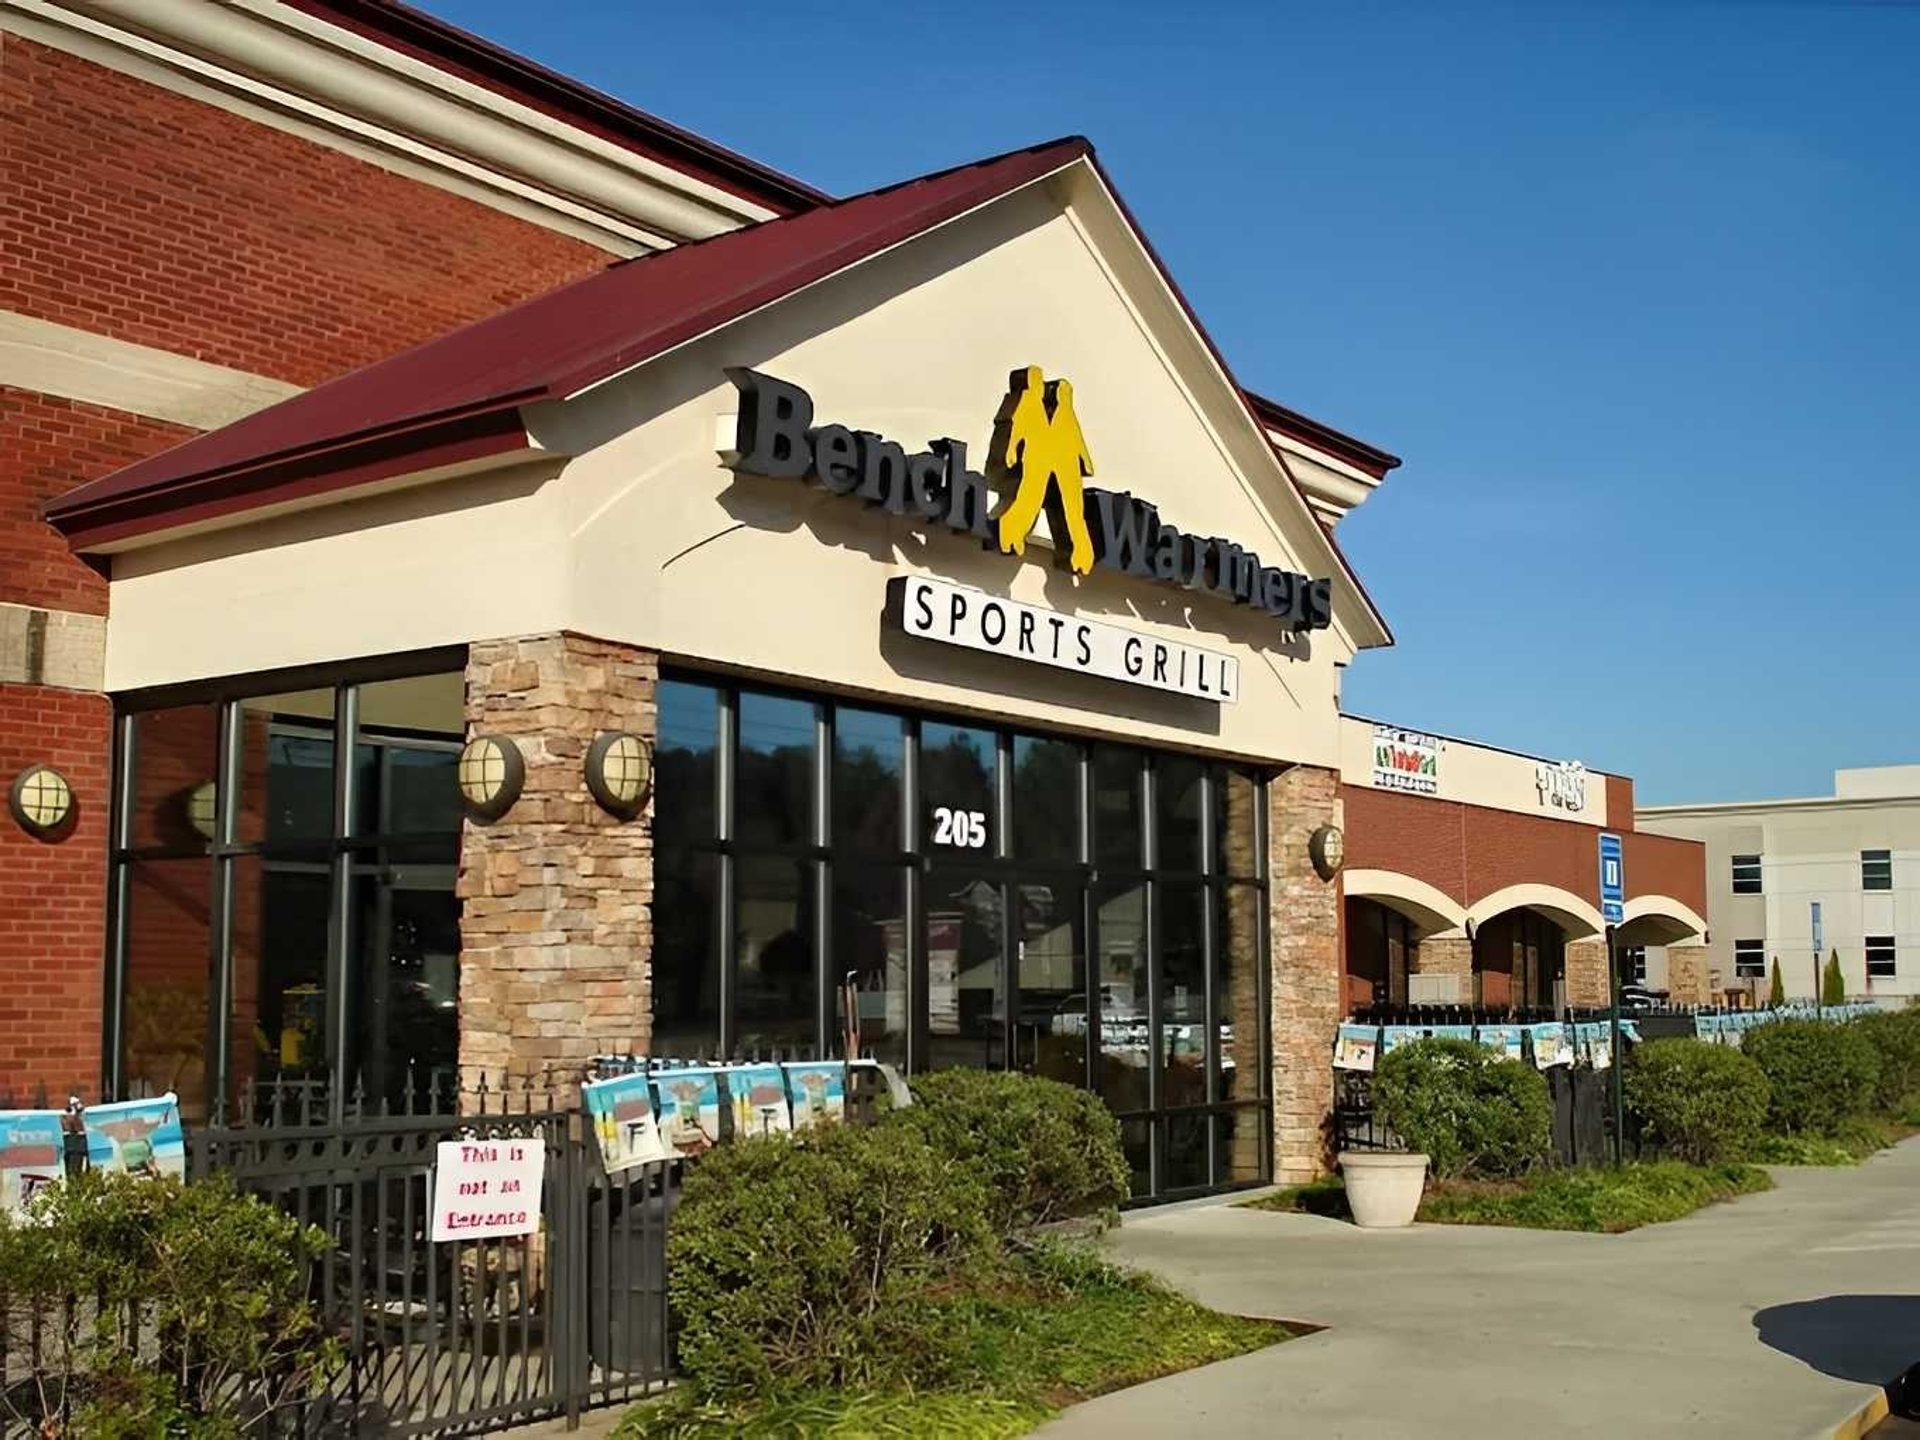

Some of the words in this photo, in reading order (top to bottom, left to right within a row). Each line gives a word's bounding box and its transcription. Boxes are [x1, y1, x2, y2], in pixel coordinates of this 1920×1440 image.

[727, 367, 997, 547] Bench
[1085, 488, 1331, 631] Warmers
[915, 585, 1091, 666] SPORTS
[1124, 637, 1231, 697] GRILL
[934, 807, 986, 848] 205
[461, 1146, 497, 1162] This
[510, 1147, 523, 1161] is
[460, 1180, 487, 1195] not
